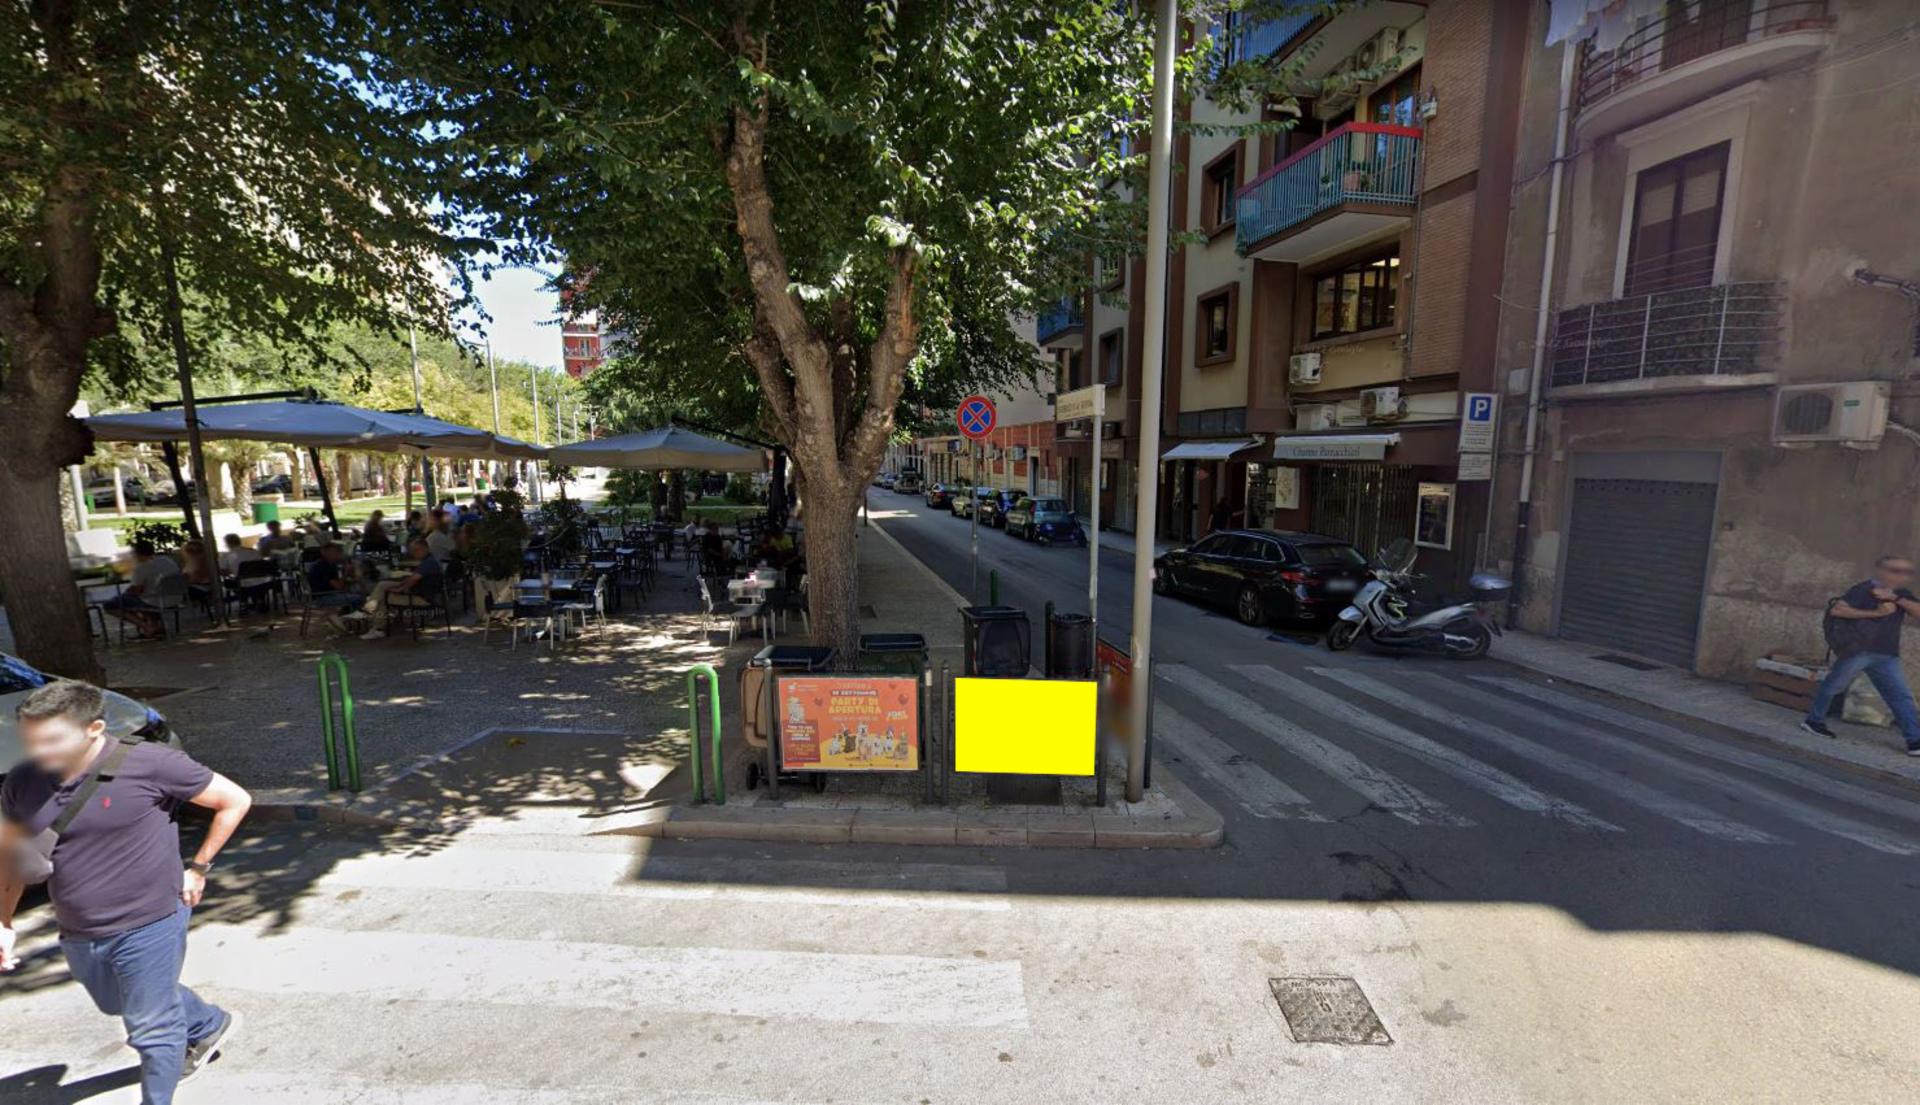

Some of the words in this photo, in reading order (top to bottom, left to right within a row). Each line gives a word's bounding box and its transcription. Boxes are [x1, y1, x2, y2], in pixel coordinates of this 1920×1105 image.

[1474, 399, 1488, 418] P
[832, 697, 864, 705] PARTY
[828, 705, 881, 714] APERTURA
